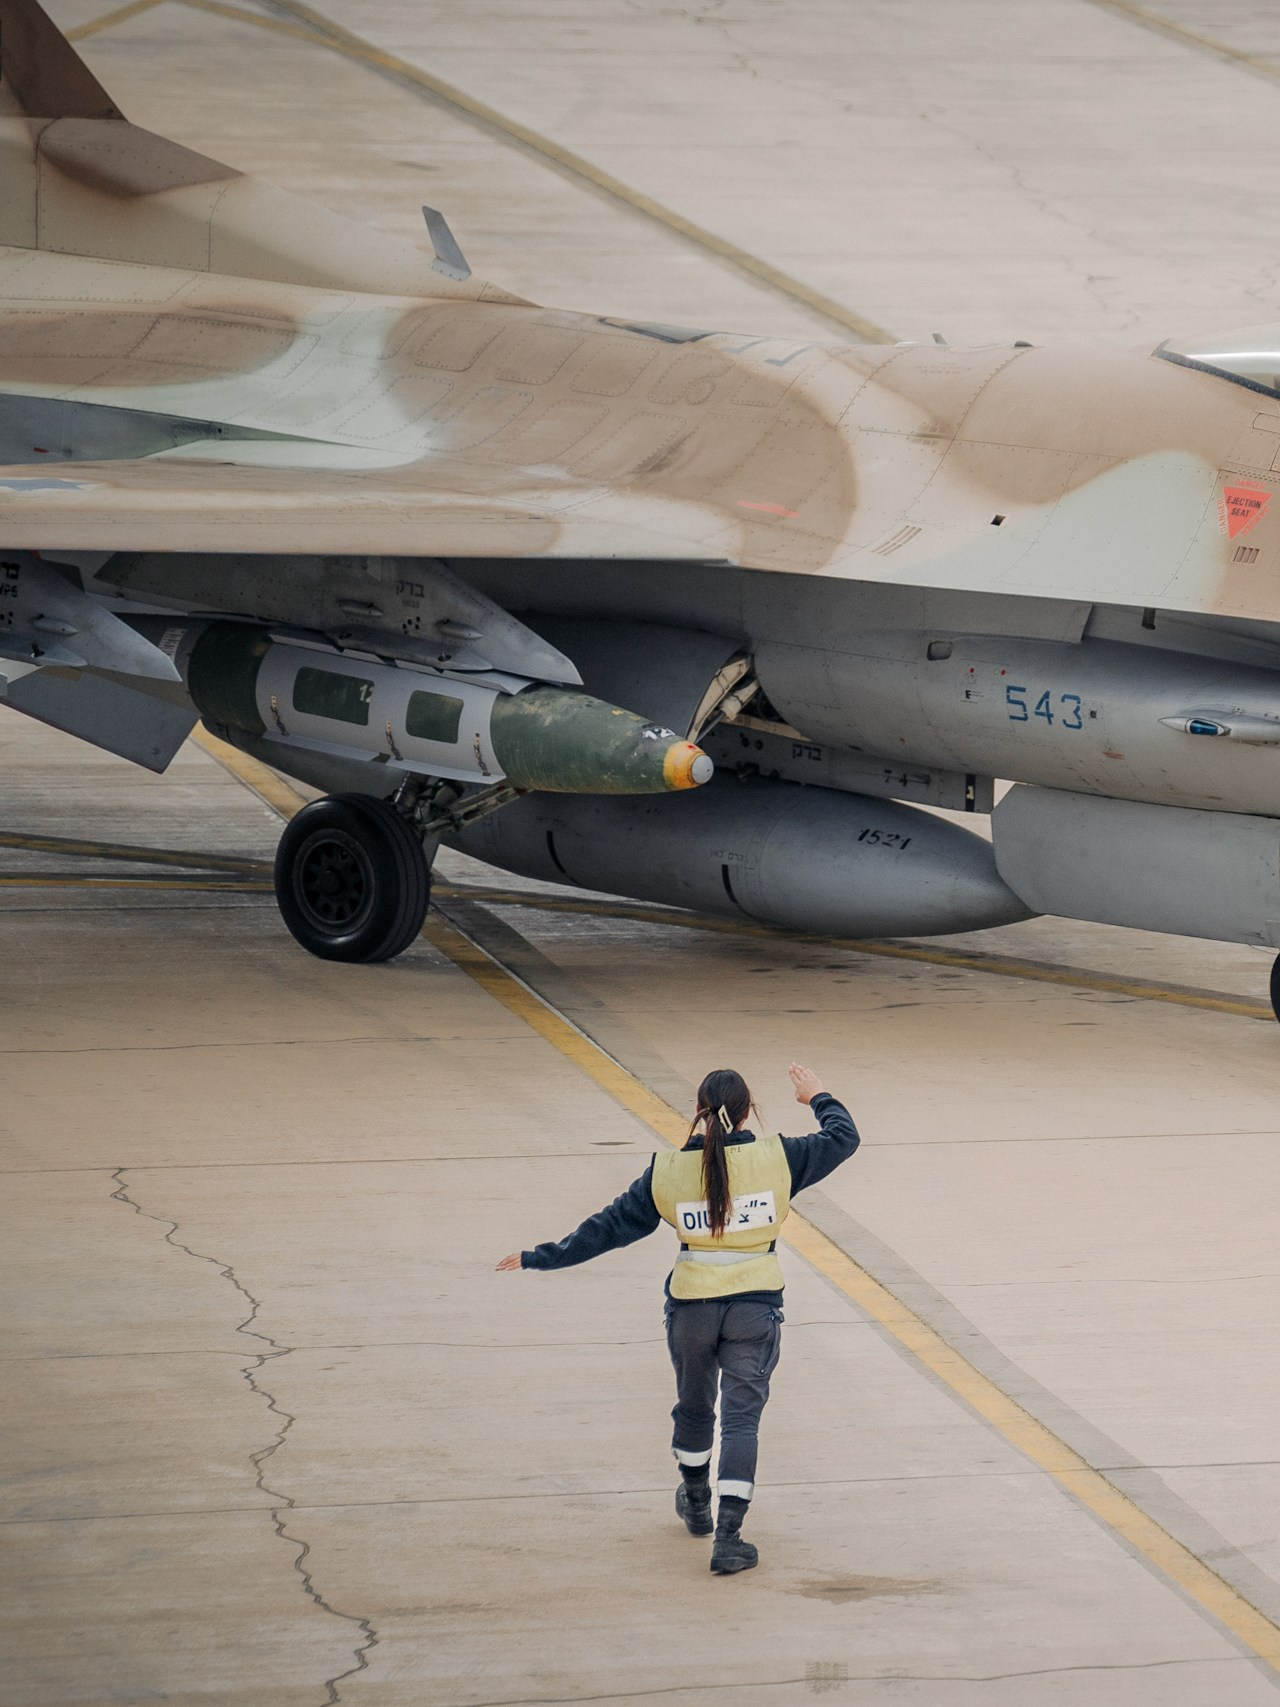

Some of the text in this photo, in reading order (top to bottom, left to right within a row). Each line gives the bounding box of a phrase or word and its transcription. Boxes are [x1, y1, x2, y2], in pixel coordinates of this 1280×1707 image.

[1232, 478, 1266, 490] DANGER
[1227, 496, 1262, 509] EJECTION
[1231, 507, 1250, 517] SEAT
[394, 580, 425, 598] ברק
[1006, 685, 1082, 729] 543
[792, 743, 822, 761] ברק
[857, 828, 912, 850] 1521
